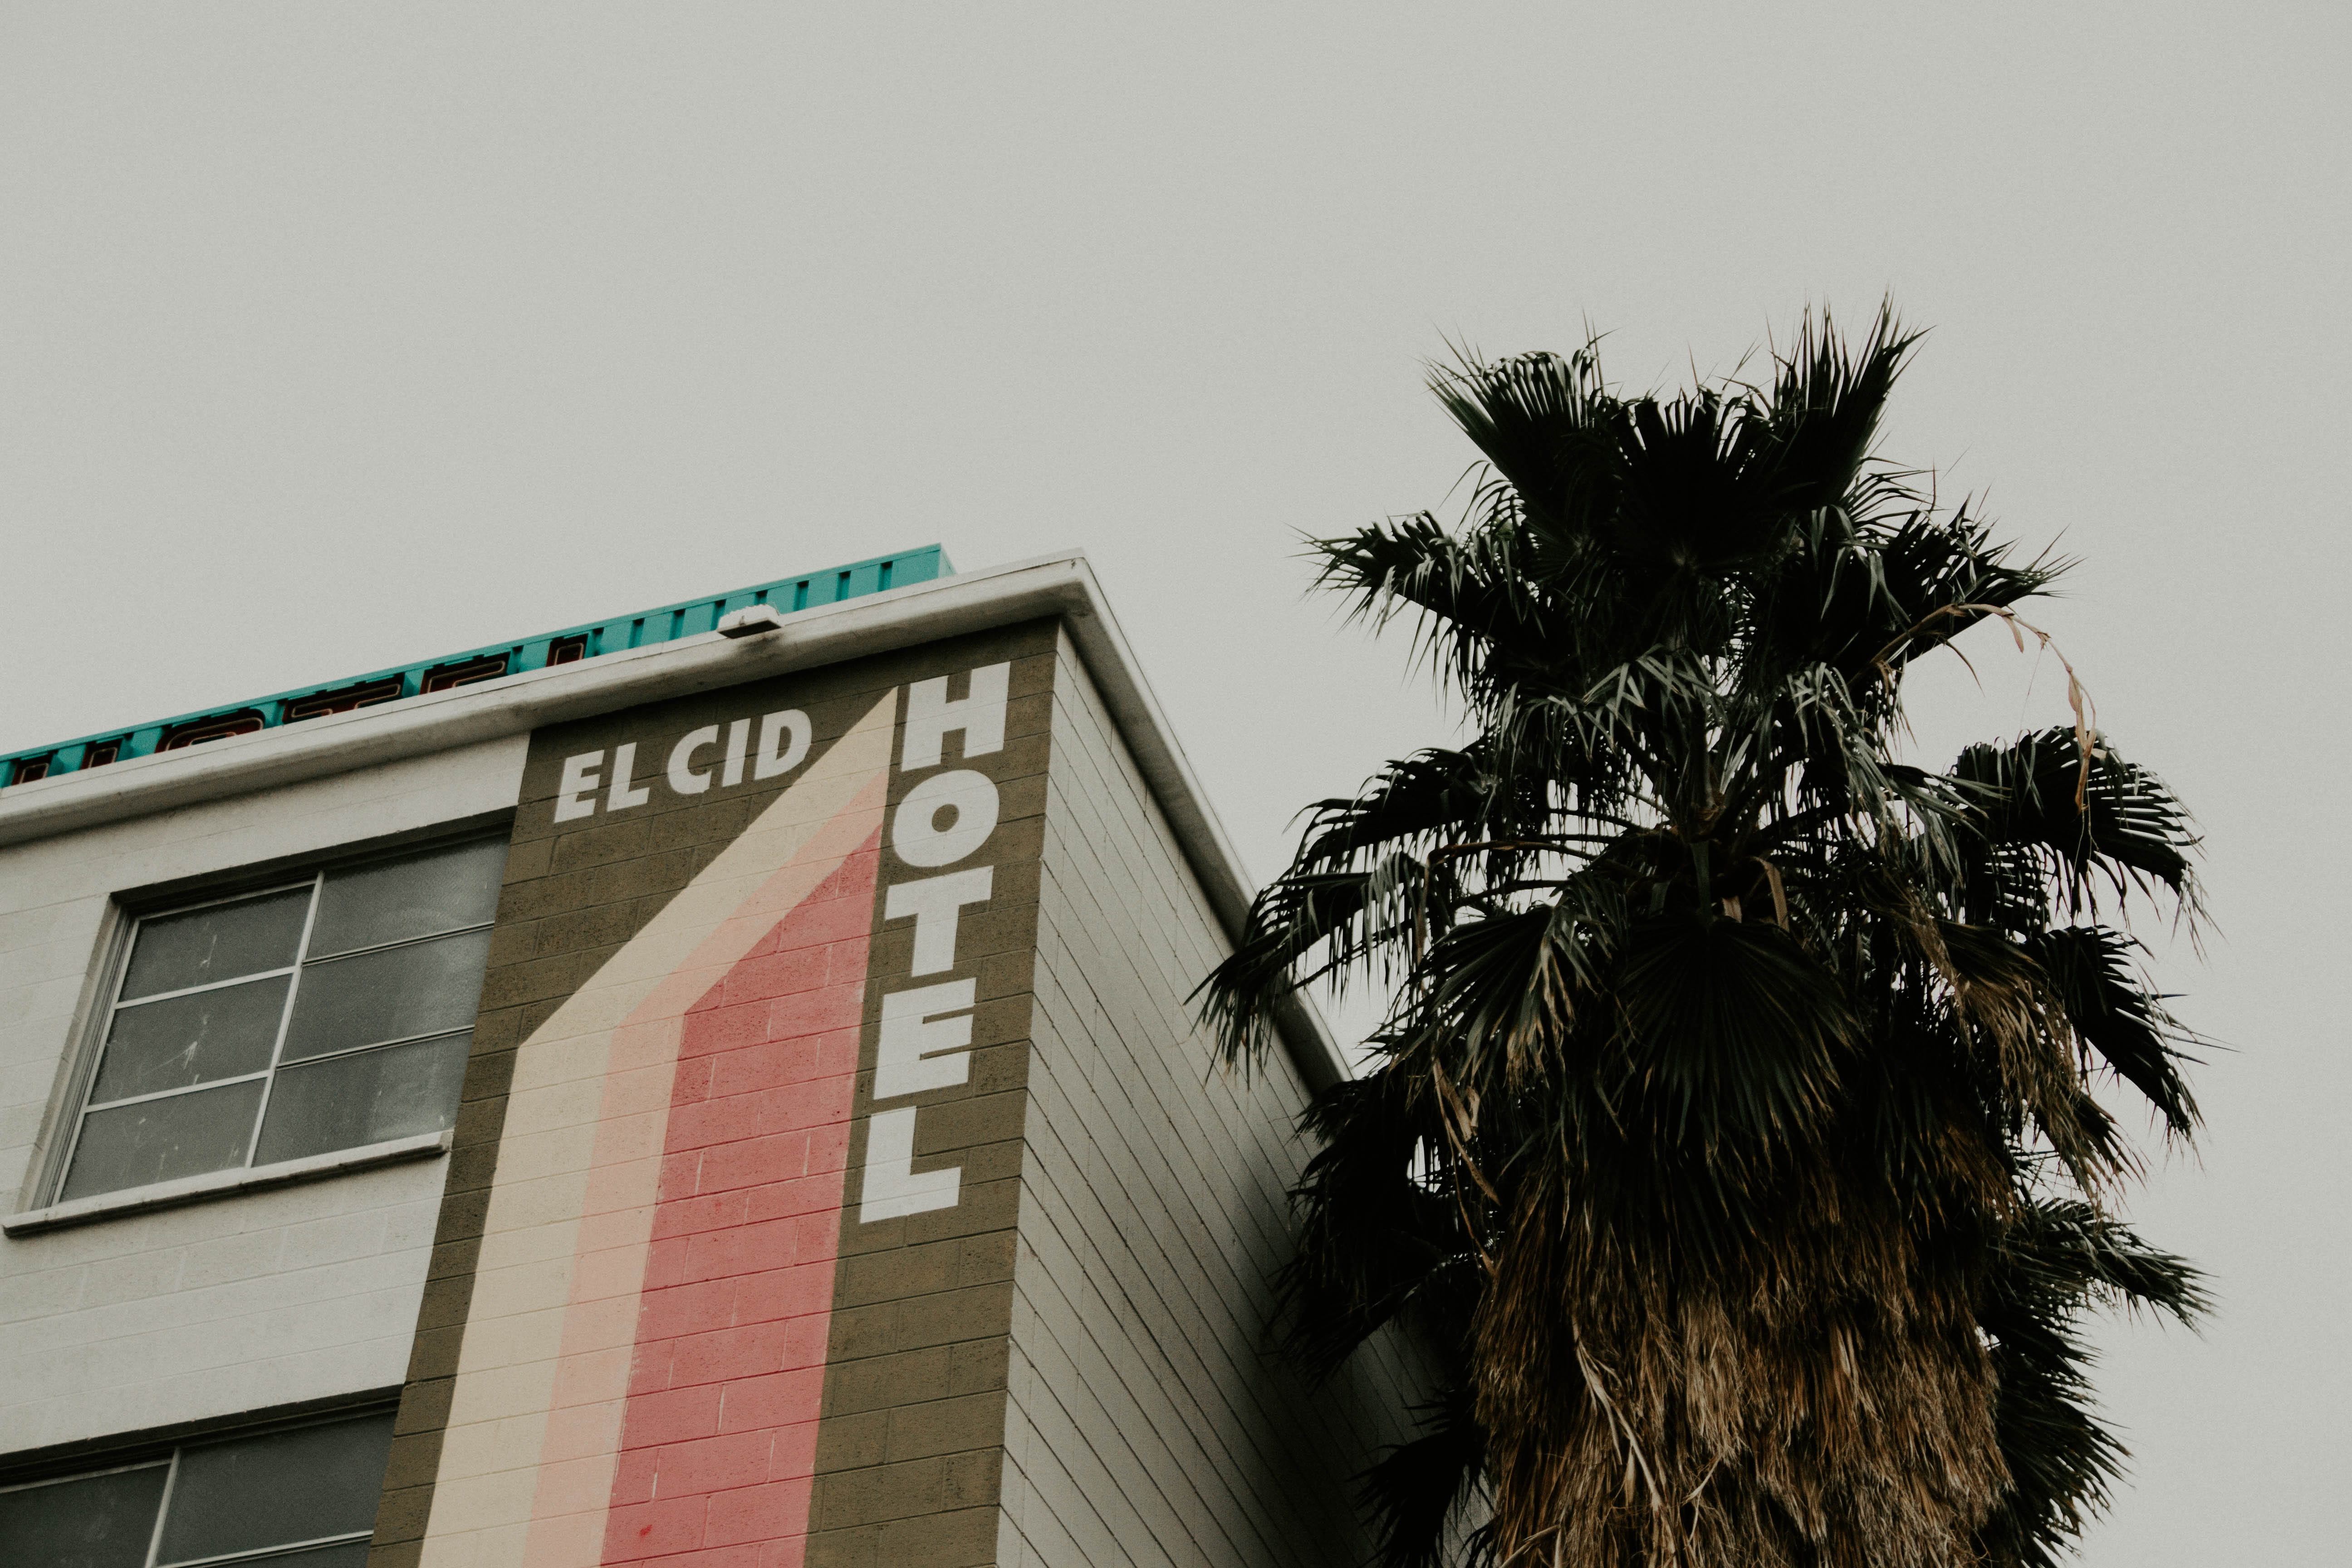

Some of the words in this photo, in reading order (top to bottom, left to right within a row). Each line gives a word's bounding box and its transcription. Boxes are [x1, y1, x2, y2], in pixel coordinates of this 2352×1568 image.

[554, 742, 650, 823] EL
[667, 709, 813, 794] CID
[860, 662, 1011, 1224] HOTEL
